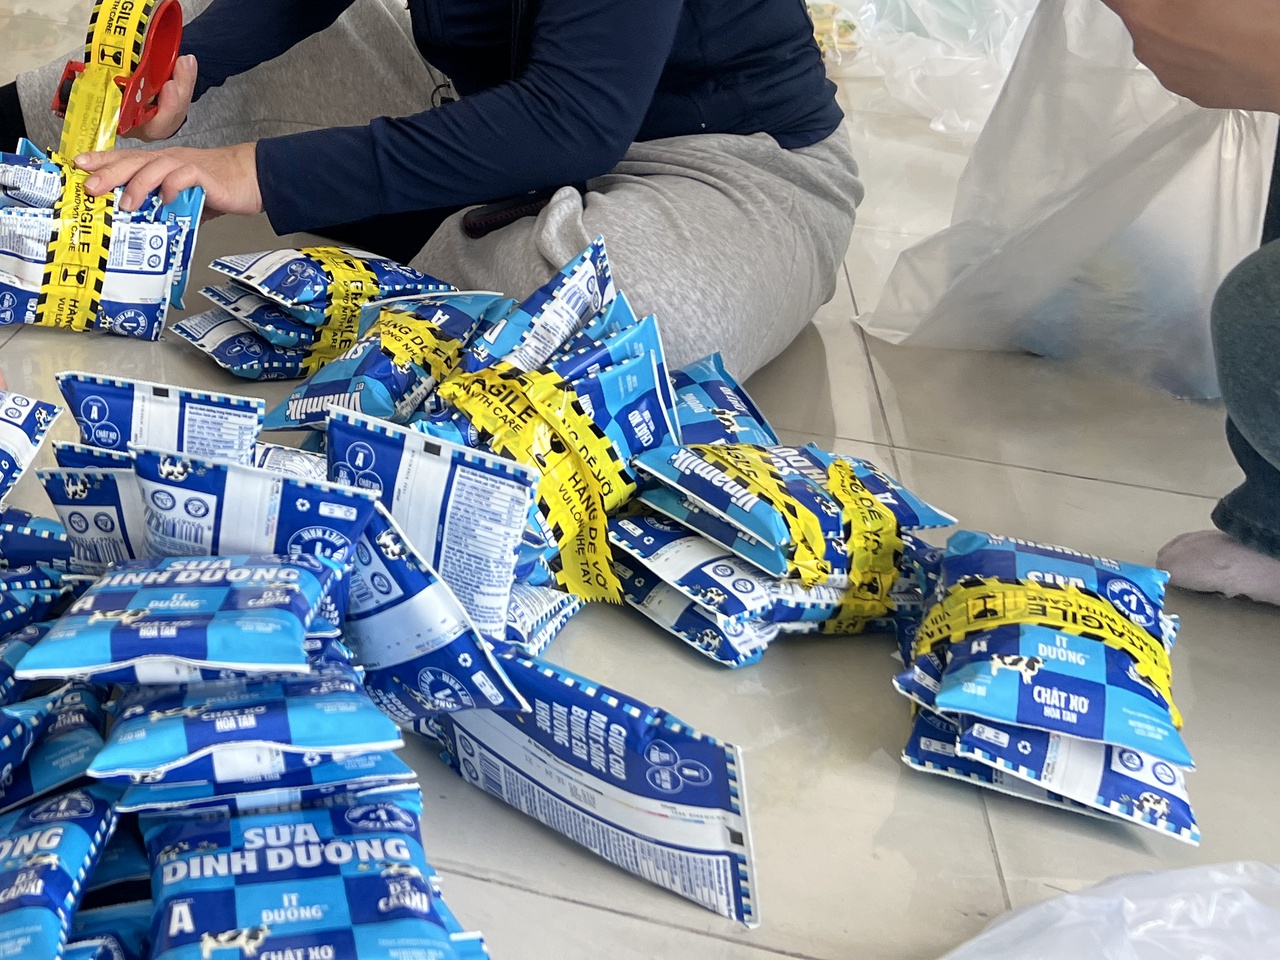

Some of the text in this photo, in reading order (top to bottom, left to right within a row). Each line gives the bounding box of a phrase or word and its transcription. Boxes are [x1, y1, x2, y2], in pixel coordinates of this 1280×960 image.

[78, 192, 96, 254] RAGILE
[470, 377, 540, 426] AGILE
[493, 406, 523, 434] CARE
[671, 448, 761, 513] Vinamilk
[579, 559, 593, 586] TAY
[162, 850, 258, 886] DINH
[169, 903, 195, 937] A
